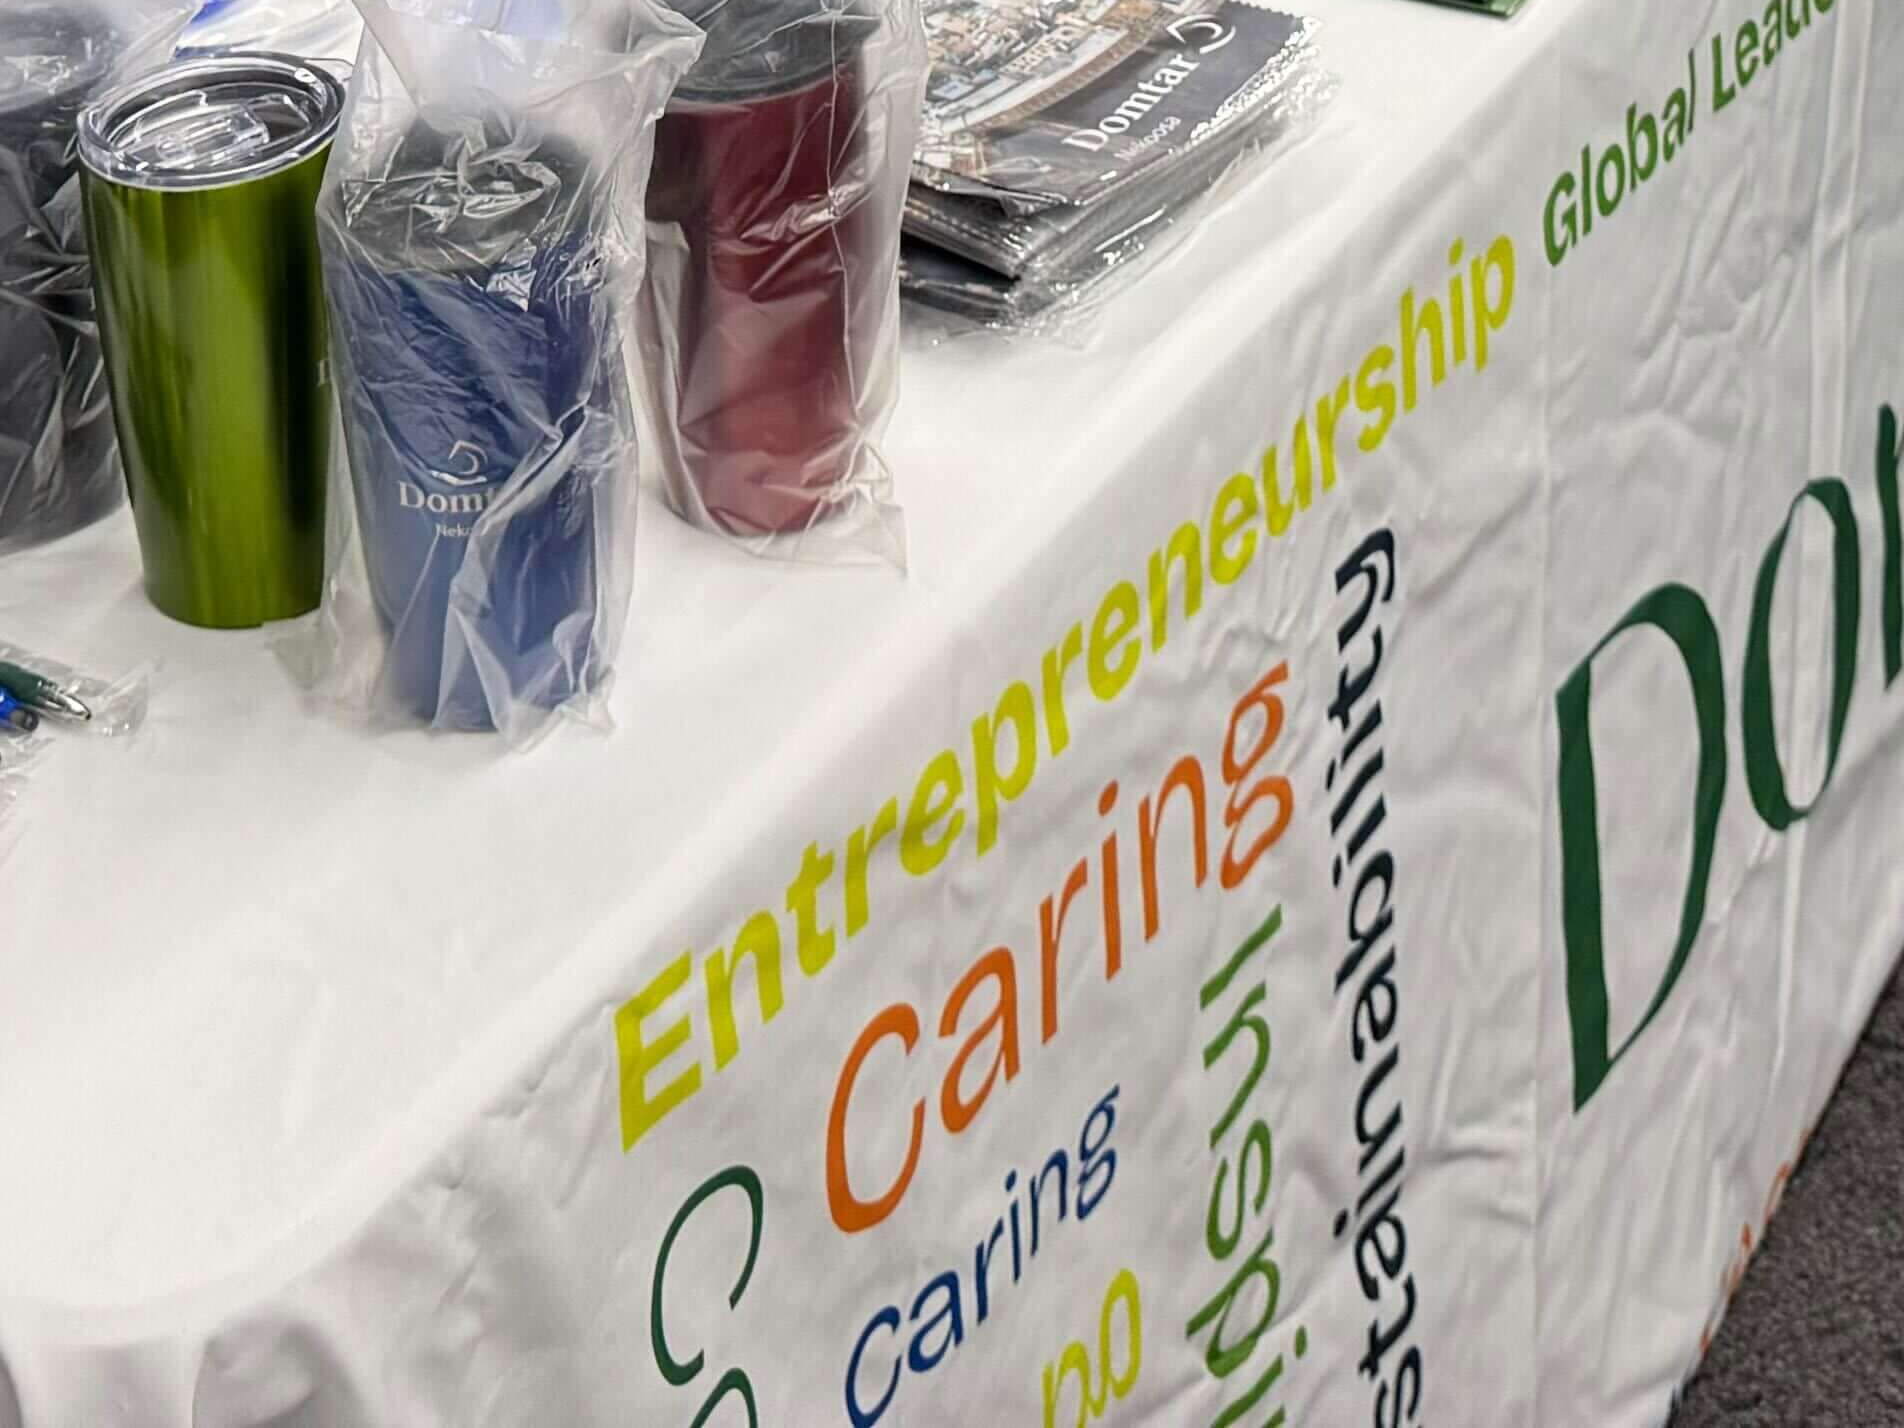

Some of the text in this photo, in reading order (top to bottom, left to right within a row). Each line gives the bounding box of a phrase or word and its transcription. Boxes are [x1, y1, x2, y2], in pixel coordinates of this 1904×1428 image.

[1061, 53, 1201, 154] Domtar
[1542, 44, 1699, 268] Global
[613, 234, 1514, 1153] Entrepreneurship
[824, 660, 1296, 1236] Caring
